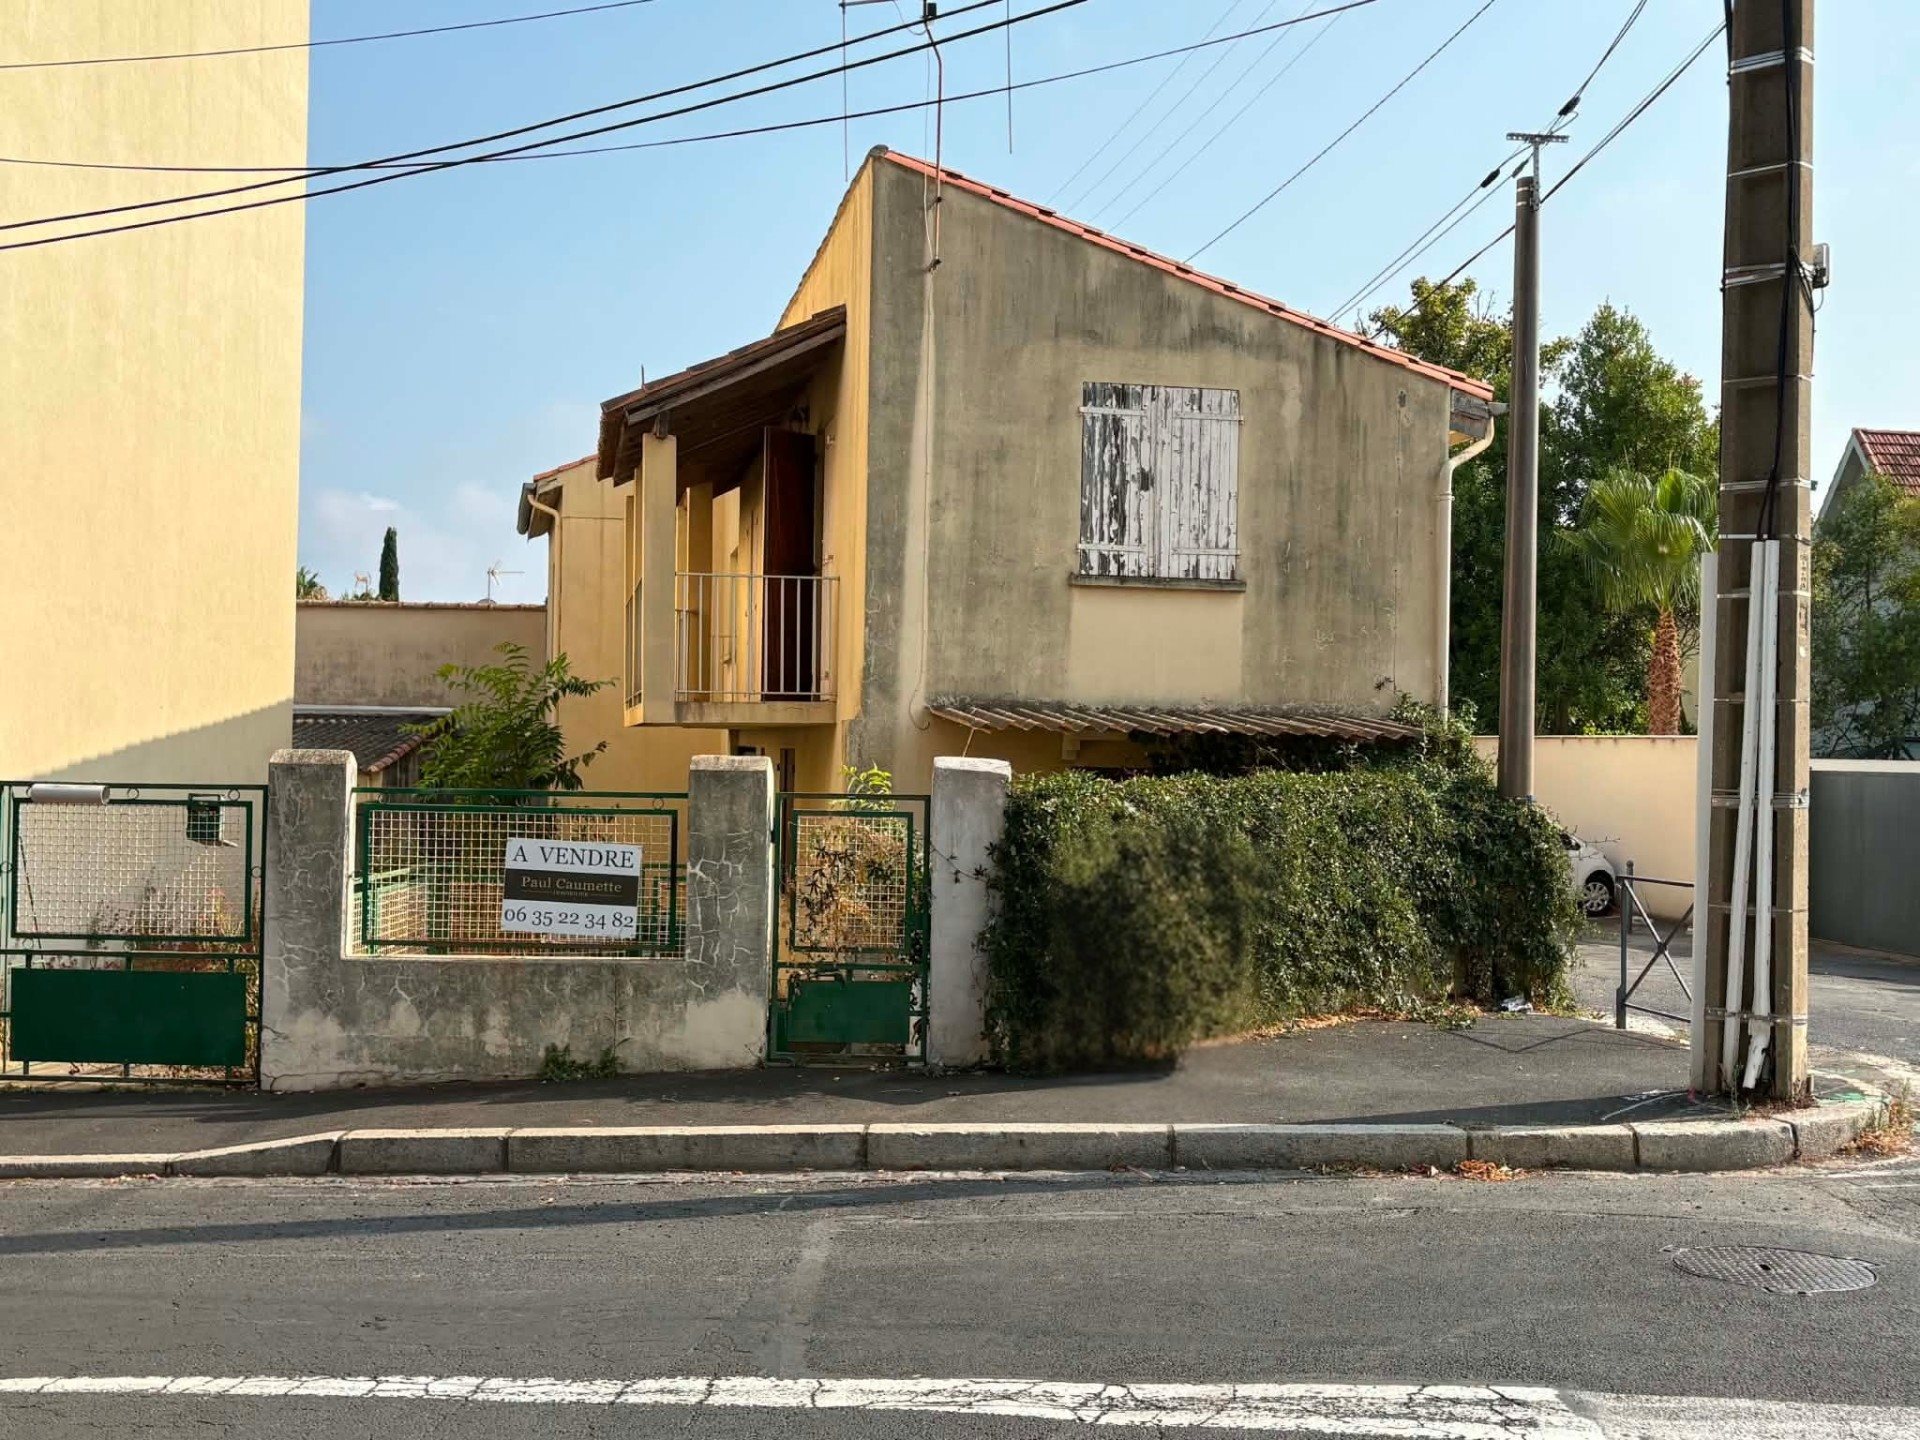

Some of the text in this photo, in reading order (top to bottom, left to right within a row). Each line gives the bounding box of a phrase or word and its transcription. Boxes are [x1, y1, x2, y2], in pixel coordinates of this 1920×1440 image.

[513, 845, 634, 868] A VENDRE
[521, 876, 551, 888] Paul
[556, 878, 622, 893] Caumette
[504, 906, 634, 929] 06 35 22 34 82
